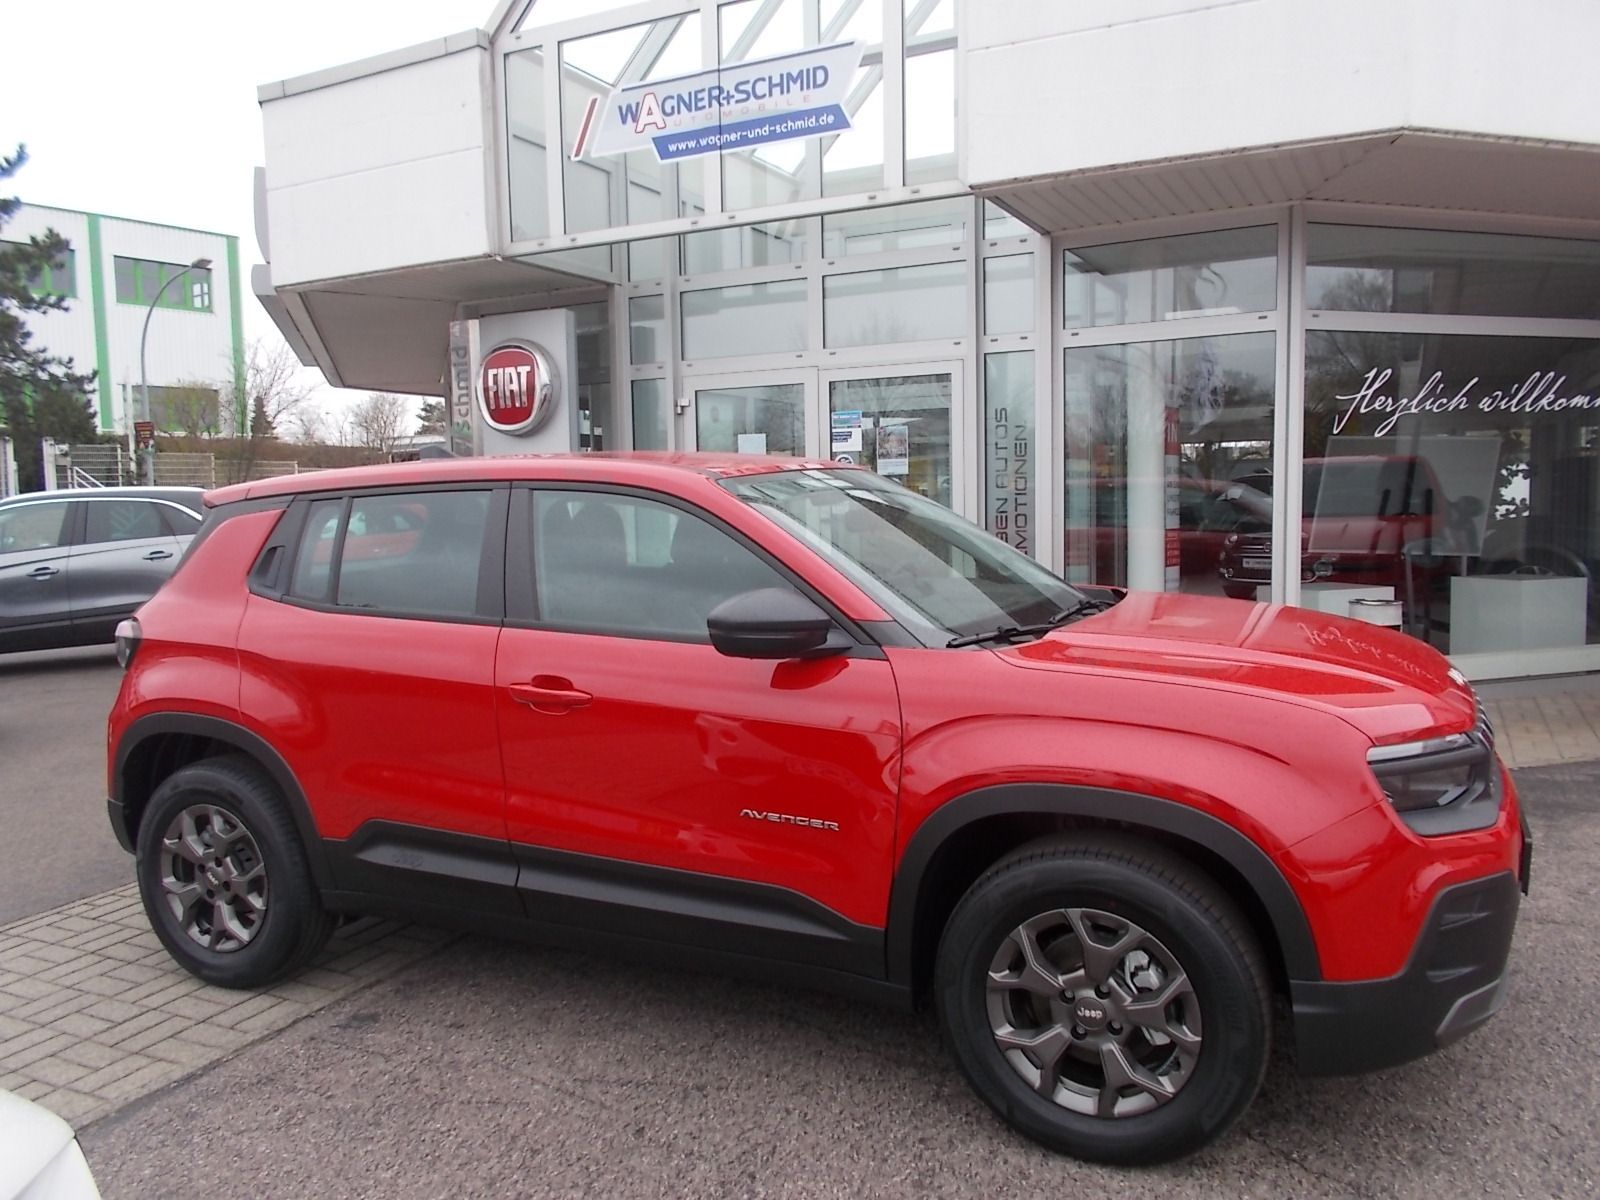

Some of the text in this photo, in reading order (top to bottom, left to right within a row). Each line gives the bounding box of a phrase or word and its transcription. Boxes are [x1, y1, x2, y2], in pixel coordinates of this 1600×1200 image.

[668, 112, 835, 153] www.wagner-und-schmid.de
[487, 365, 531, 410] FIAT
[1333, 367, 1479, 438] Herzlich
[740, 808, 840, 832] AVENGER
[1077, 1009, 1103, 1020] Jeep
